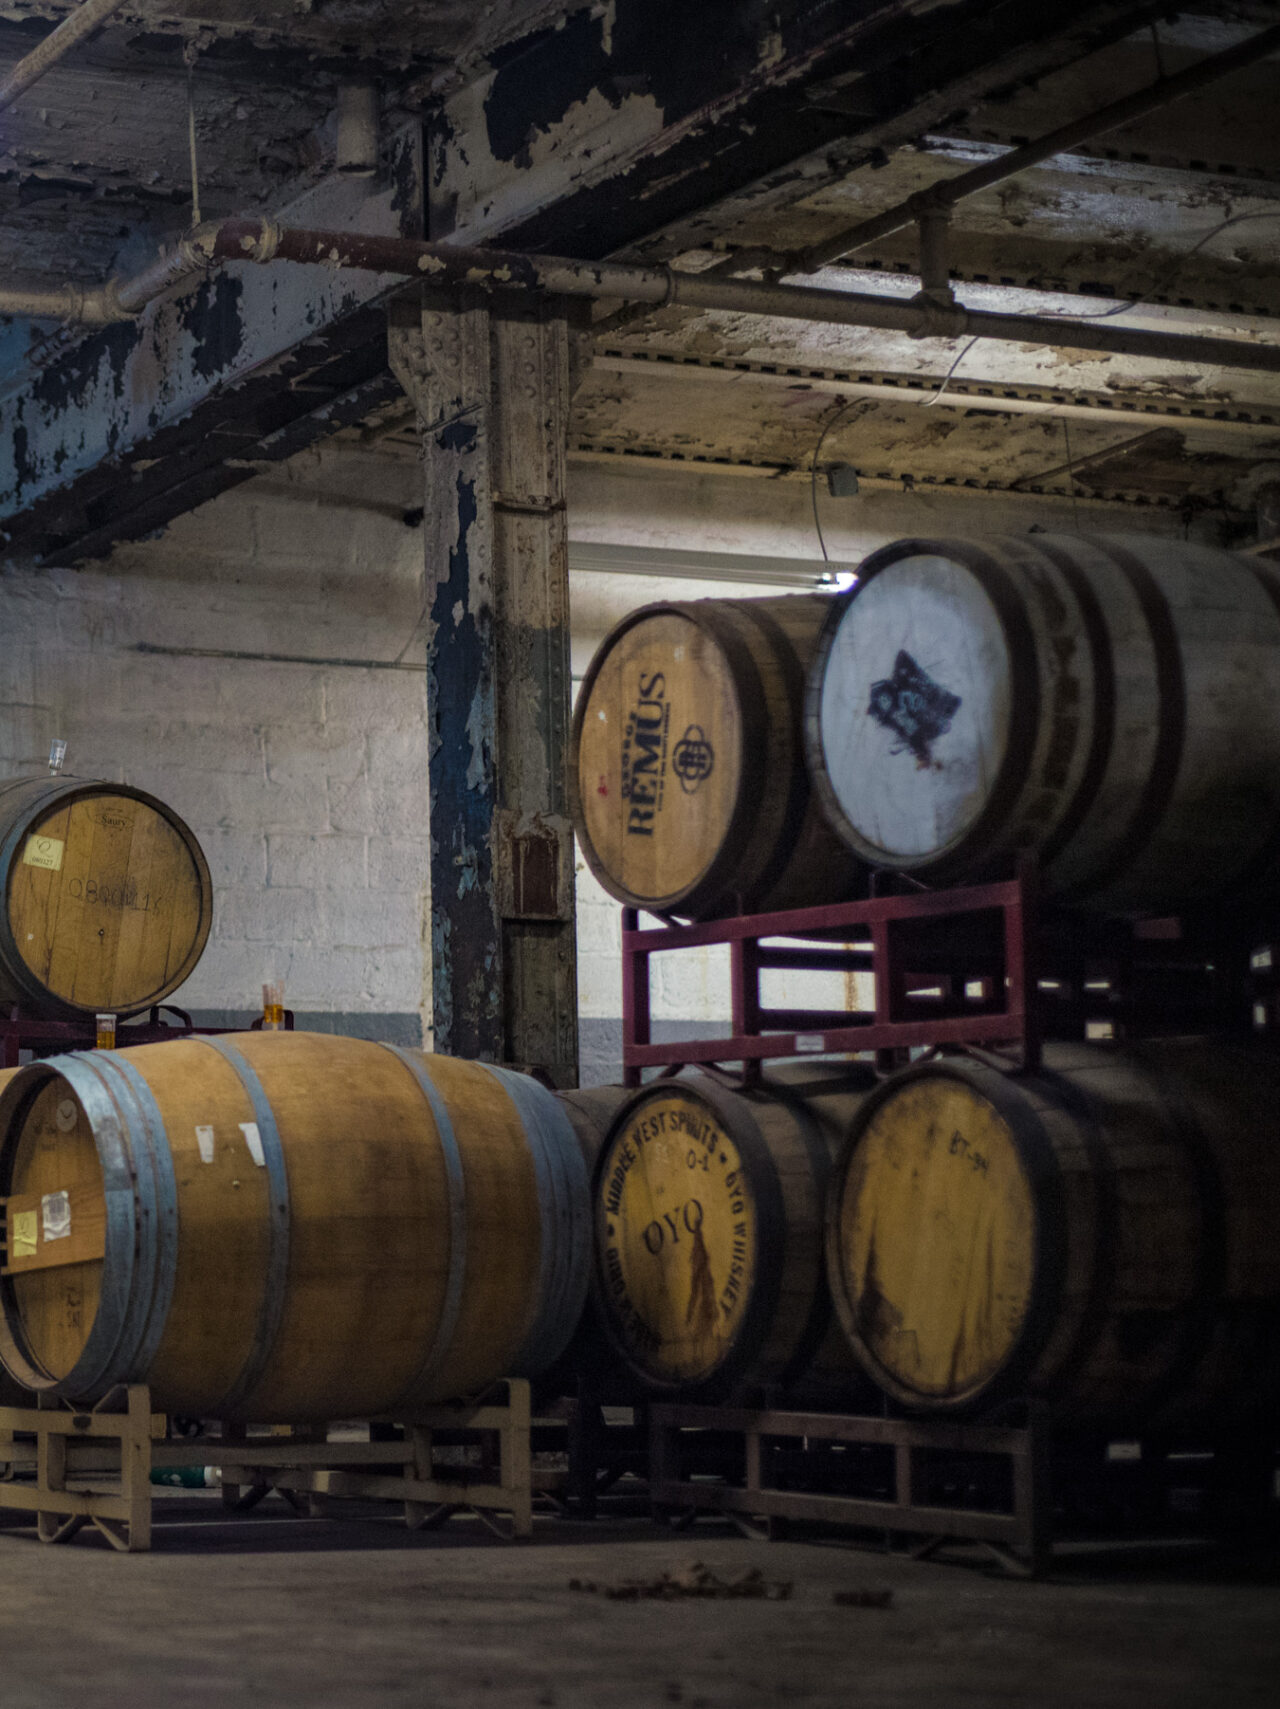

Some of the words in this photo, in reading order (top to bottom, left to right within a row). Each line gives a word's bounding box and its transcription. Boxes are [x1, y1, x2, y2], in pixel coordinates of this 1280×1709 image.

[627, 670, 666, 837] REMUS
[605, 1141, 637, 1216] MIDDLE
[631, 1112, 667, 1150] WEST
[669, 1110, 719, 1154] SPIRITS
[724, 1170, 745, 1215] OYO
[643, 1198, 704, 1256] OYO
[720, 1221, 748, 1316] WHISKEY
